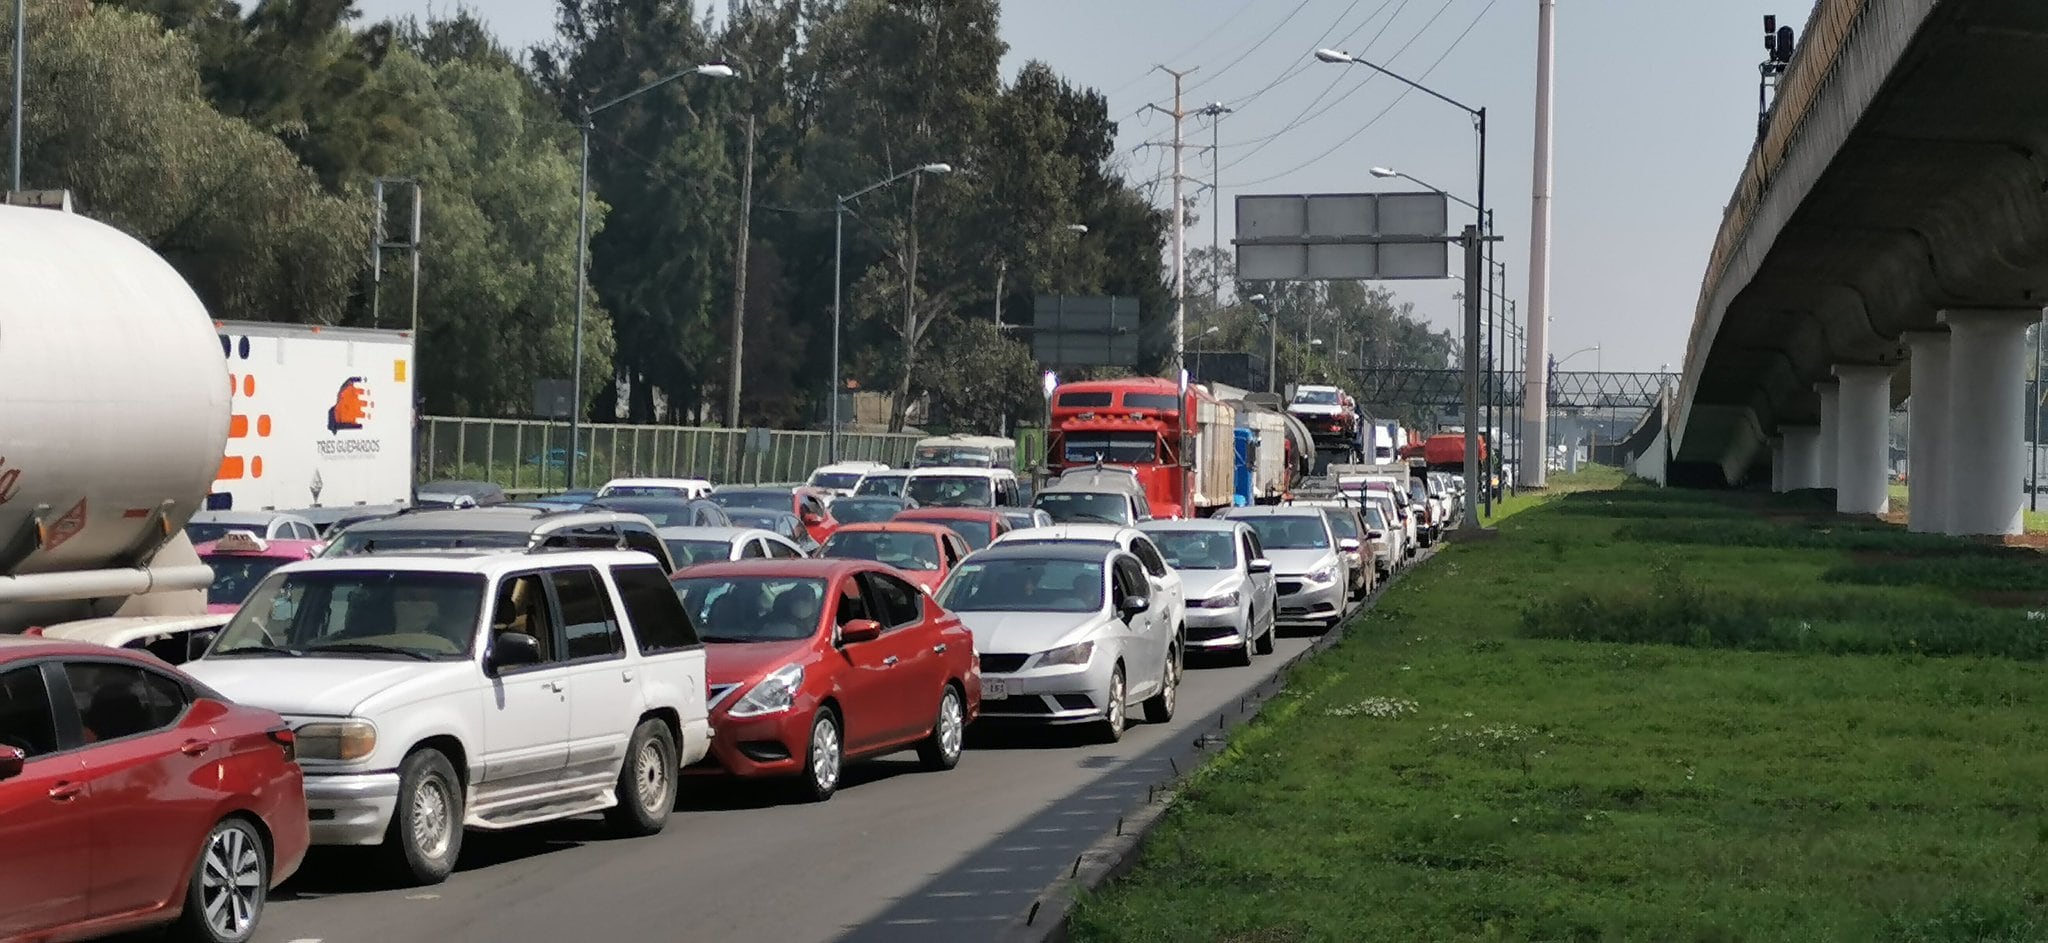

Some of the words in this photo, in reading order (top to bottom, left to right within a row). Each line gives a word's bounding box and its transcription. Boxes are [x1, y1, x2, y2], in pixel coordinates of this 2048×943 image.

[317, 440, 335, 453] TRES
[336, 439, 380, 452] GUEPARDOS
[227, 534, 250, 542] TAXI
